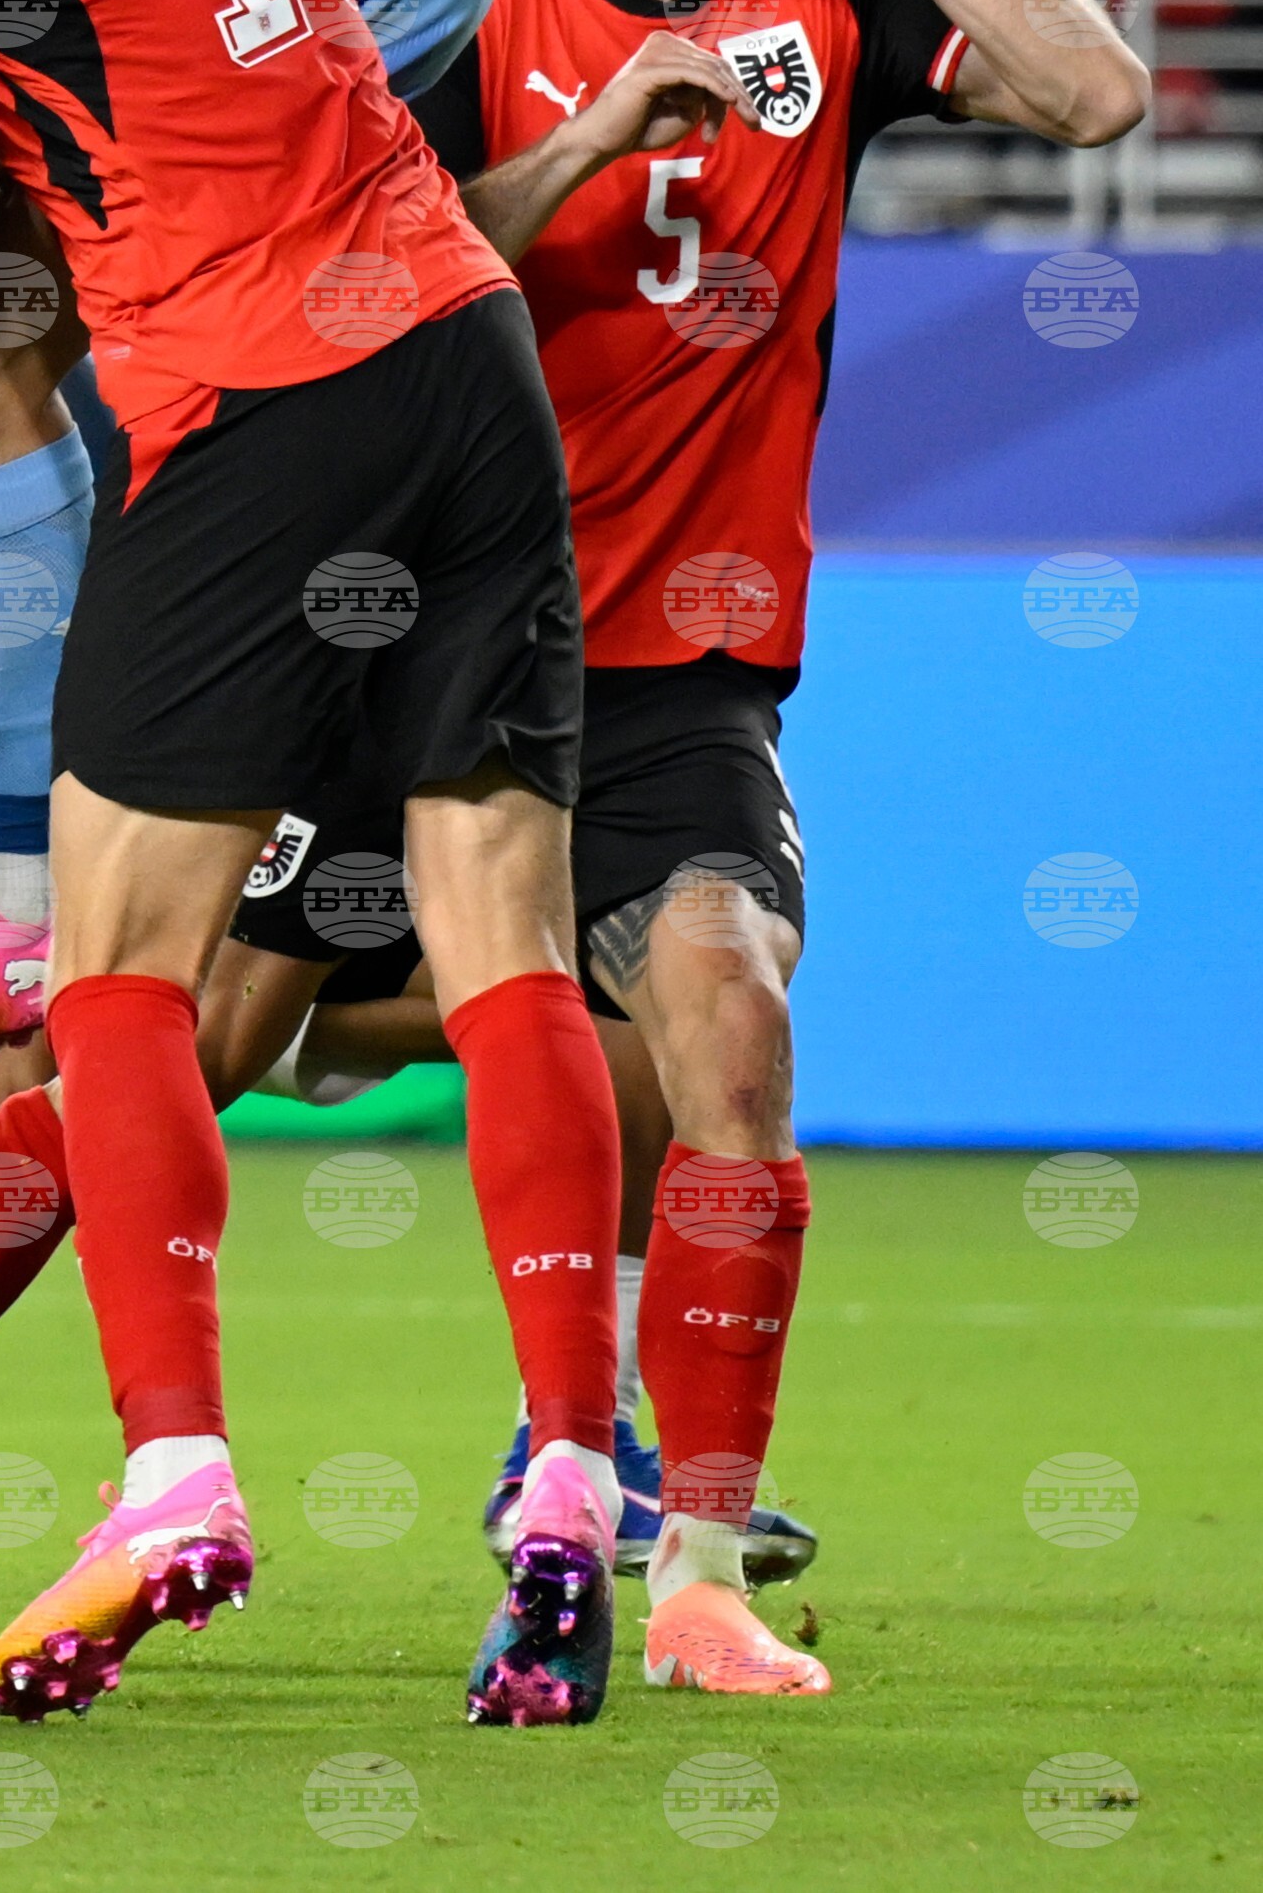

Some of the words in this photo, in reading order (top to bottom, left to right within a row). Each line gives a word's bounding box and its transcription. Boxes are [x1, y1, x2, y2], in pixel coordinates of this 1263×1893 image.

[637, 156, 705, 304] 5
[166, 1236, 217, 1271] ÖF
[511, 1252, 594, 1277] ÖFB
[683, 1306, 781, 1333] ÖFB
